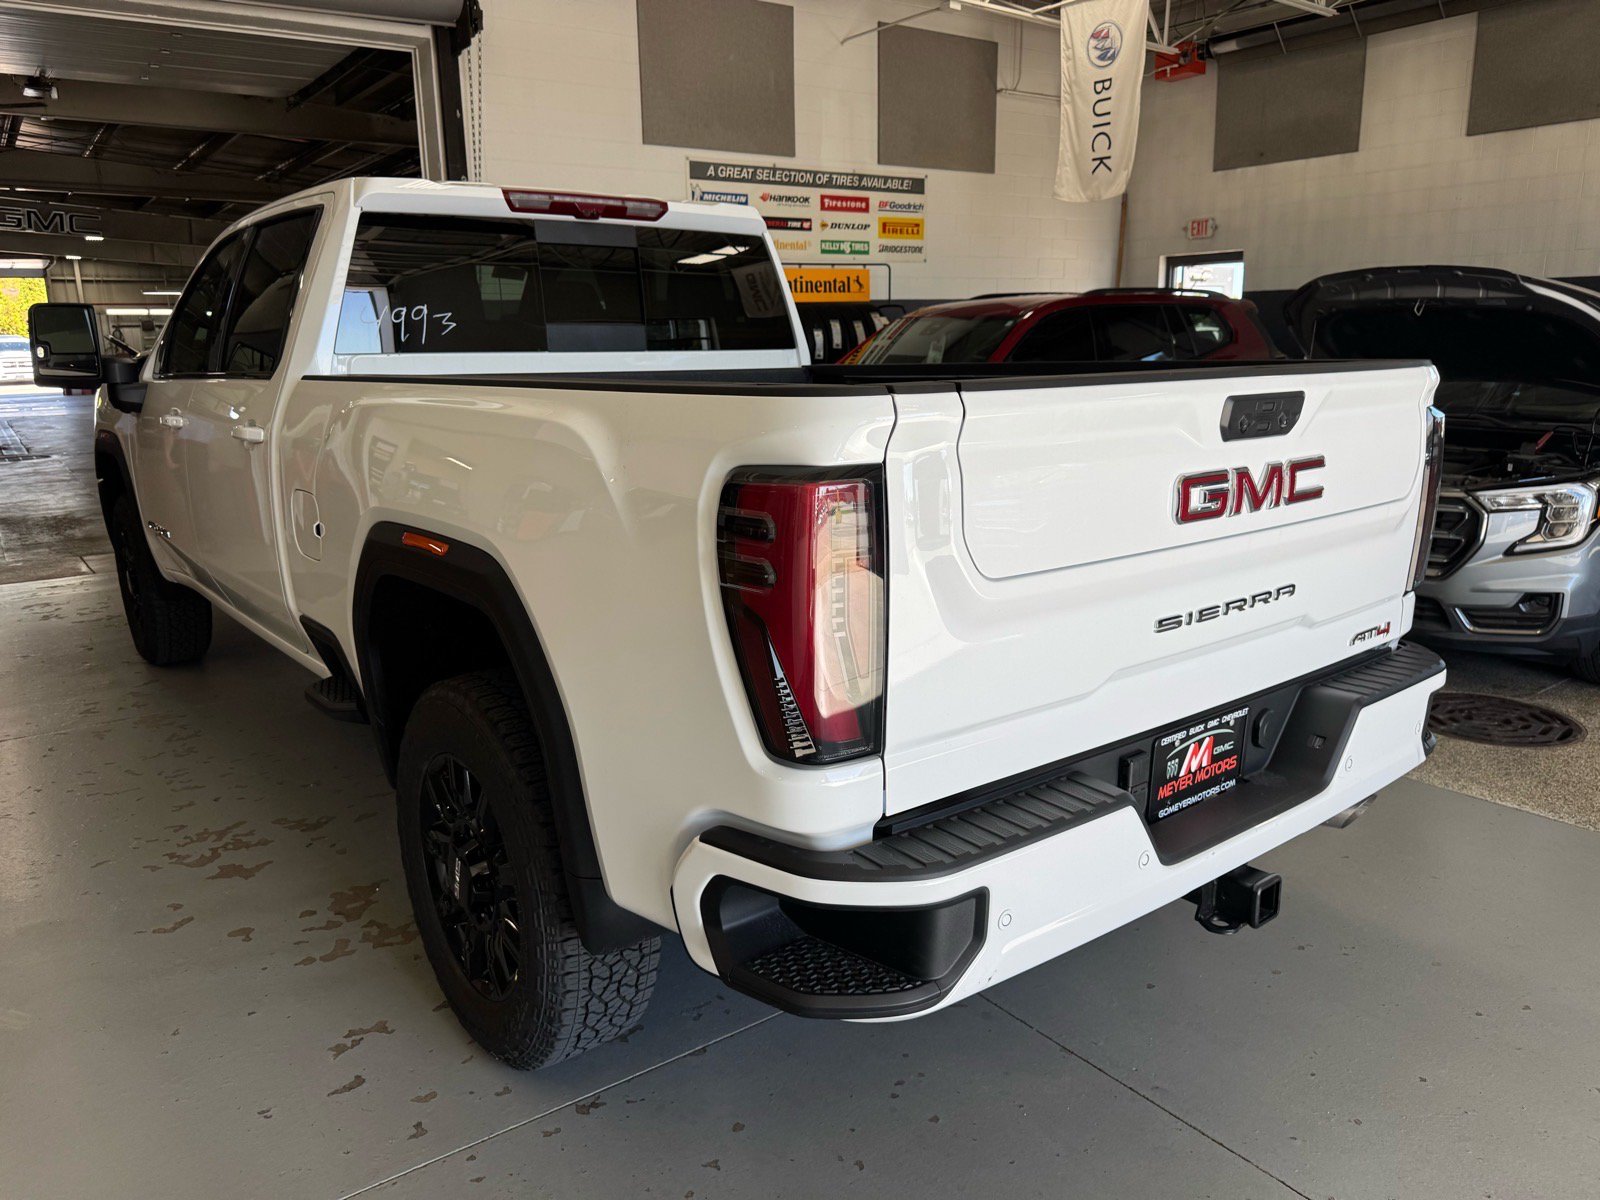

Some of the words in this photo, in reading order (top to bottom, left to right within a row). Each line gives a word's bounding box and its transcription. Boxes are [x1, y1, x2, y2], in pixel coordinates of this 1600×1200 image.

[1091, 77, 1112, 175] BUICK
[707, 164, 715, 177] A
[718, 166, 754, 180] GREAT
[756, 168, 813, 184] SELECTION
[815, 173, 830, 185] OF
[832, 174, 859, 187] TIRES
[860, 176, 912, 190] AVAILABLE!
[702, 193, 747, 203] MICHELIN
[823, 198, 866, 209] Firestone
[878, 200, 924, 211] BFGoodrich
[0, 206, 102, 237] GMC
[830, 222, 870, 230] DUNLOP
[882, 222, 920, 235] PIRELLI
[1190, 218, 1209, 237] EXIT
[878, 243, 924, 254] BRIDGESTONE
[1171, 454, 1326, 525] GMC
[1153, 583, 1296, 633] SIERRA
[1347, 621, 1391, 646] AT4
[1161, 730, 1187, 746] CERTIFIED
[1189, 723, 1205, 736] BUICK
[1207, 718, 1220, 728] GMC
[1221, 707, 1249, 723] CHEVROLET
[1213, 741, 1234, 755] GMC
[1157, 773, 1193, 801] MEYER
[1195, 755, 1238, 783] MOTORS
[1158, 778, 1237, 819] GOMEYERMOTORS.COM
